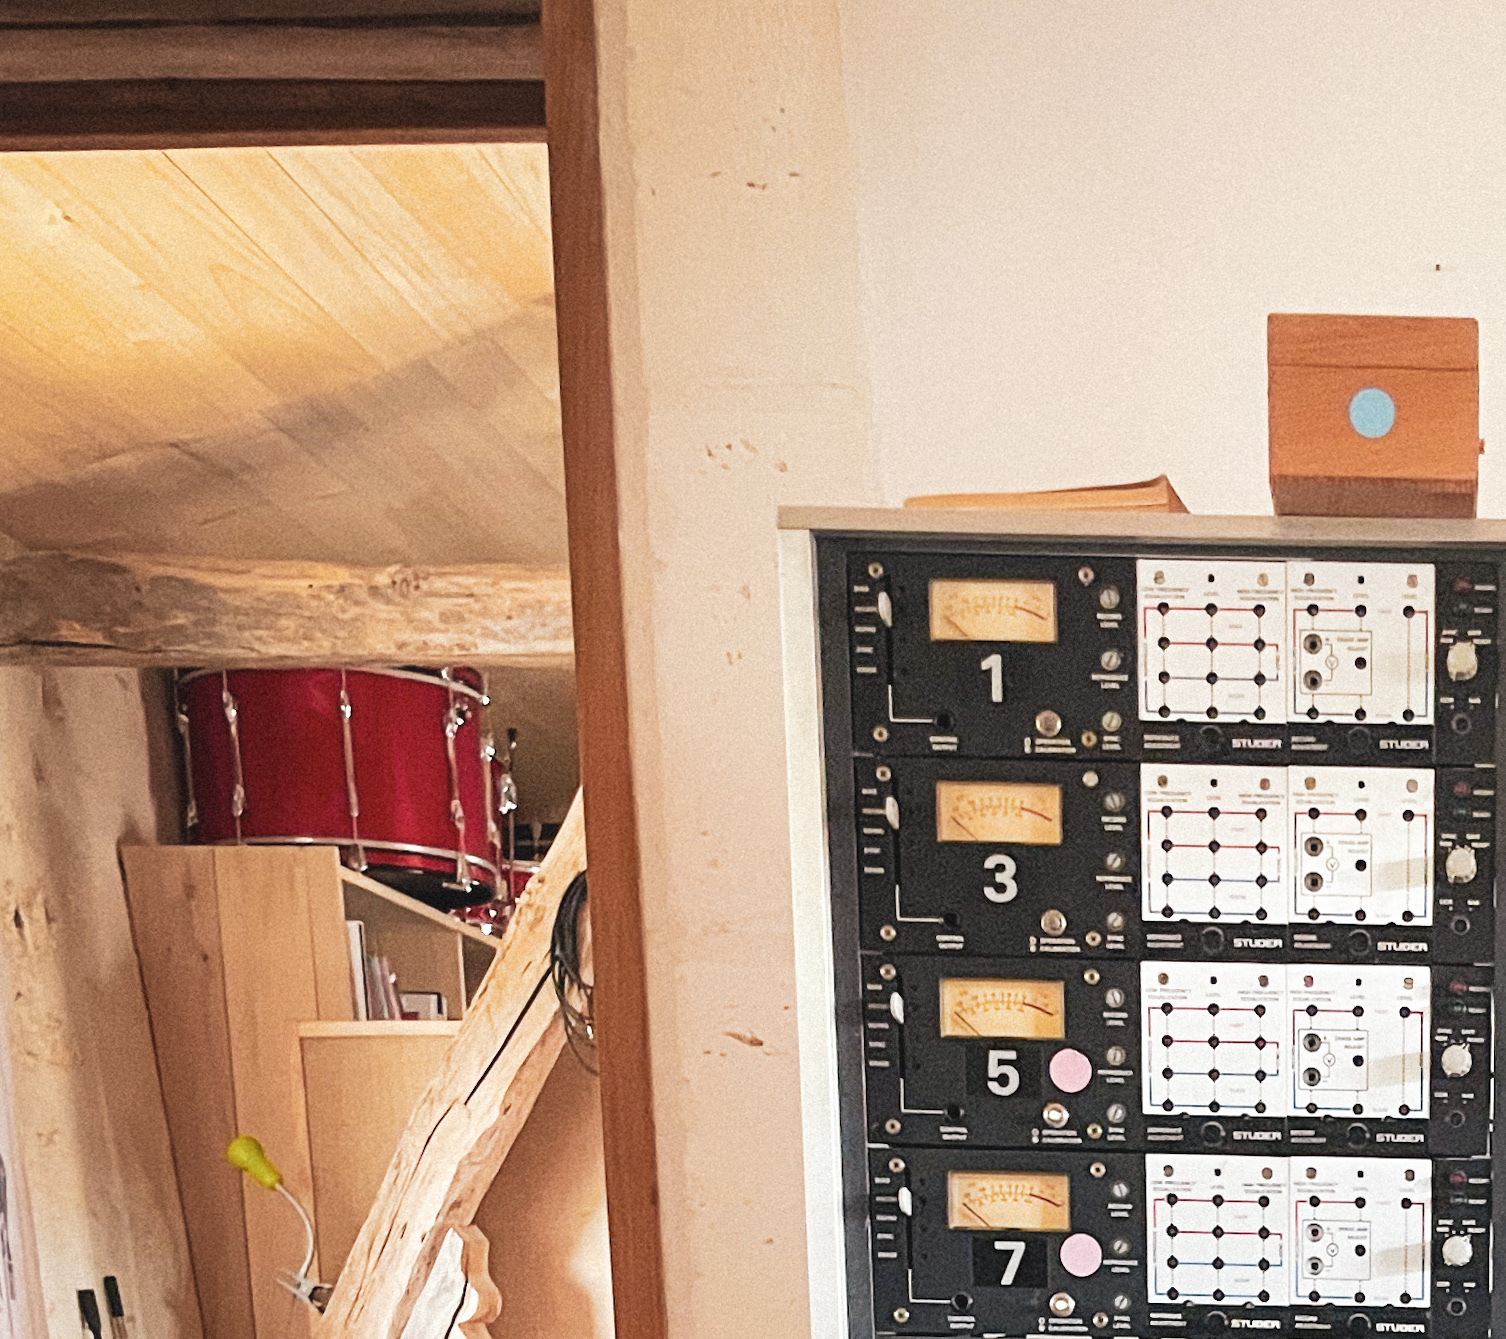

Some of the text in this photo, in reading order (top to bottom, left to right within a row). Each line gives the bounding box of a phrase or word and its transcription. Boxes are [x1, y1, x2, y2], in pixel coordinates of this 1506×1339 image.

[980, 653, 1003, 703] 1
[1231, 738, 1283, 749] STUDER
[1379, 739, 1430, 750] STUDER
[983, 854, 1018, 903] 3
[1233, 937, 1283, 949] STUDER
[1377, 941, 1429, 952] STUDER
[987, 1049, 1020, 1097] 5
[1232, 1130, 1282, 1141] STUDER
[1375, 1133, 1425, 1143] STUDER
[993, 1241, 1028, 1287] 7
[1230, 1318, 1281, 1330] STUDER
[1375, 1322, 1426, 1334] STUDER
